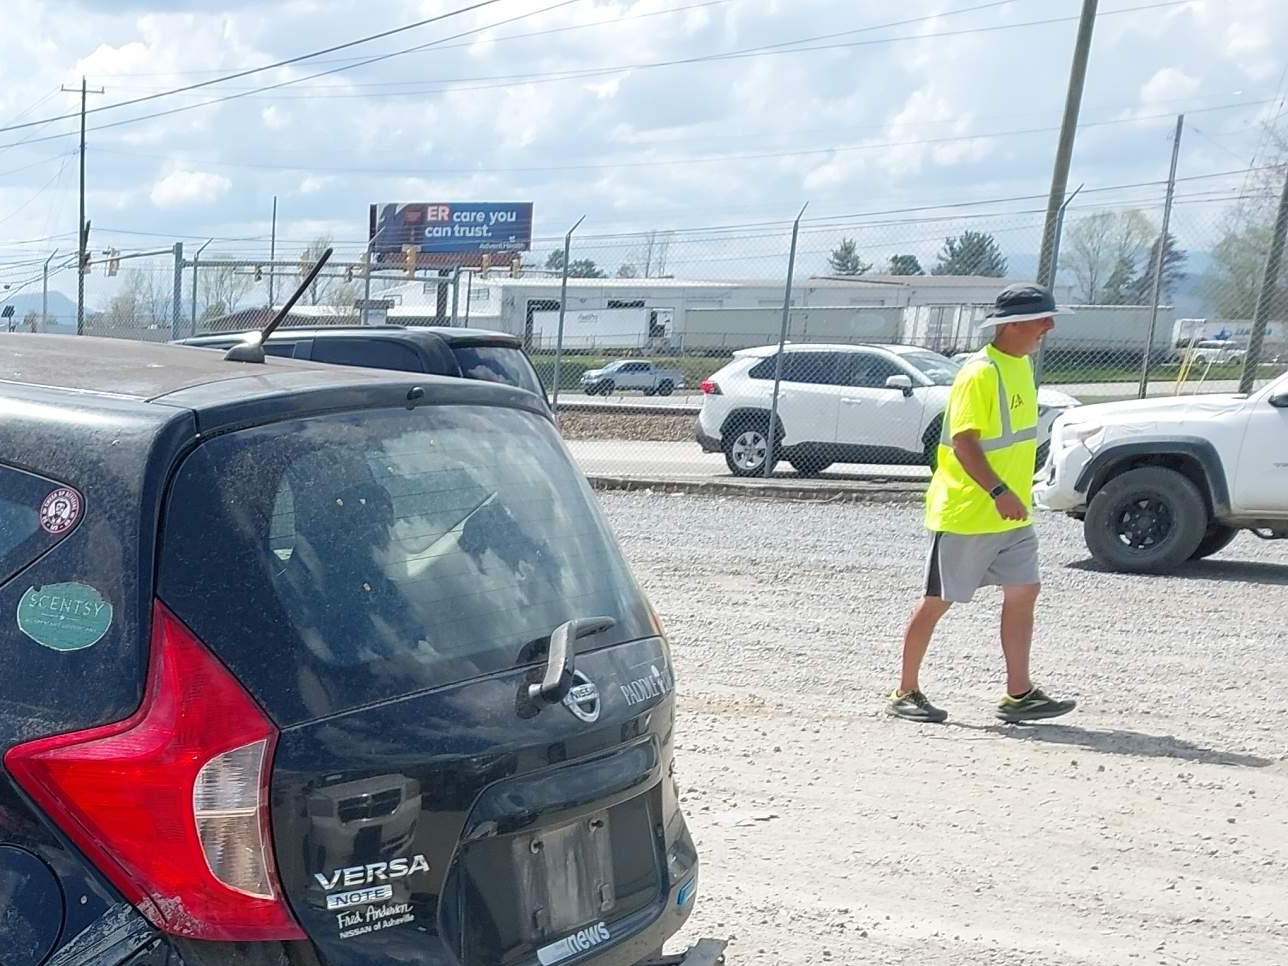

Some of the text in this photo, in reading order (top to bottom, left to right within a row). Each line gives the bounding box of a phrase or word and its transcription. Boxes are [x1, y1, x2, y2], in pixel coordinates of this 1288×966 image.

[427, 206, 516, 225] ER care you
[425, 223, 492, 237] can trust.
[29, 594, 105, 617] SCENTSY
[314, 854, 430, 890] VERSA
[335, 888, 386, 906] NOTE
[340, 926, 372, 939] NISSAN
[373, 921, 382, 931] of
[567, 921, 610, 953] news
